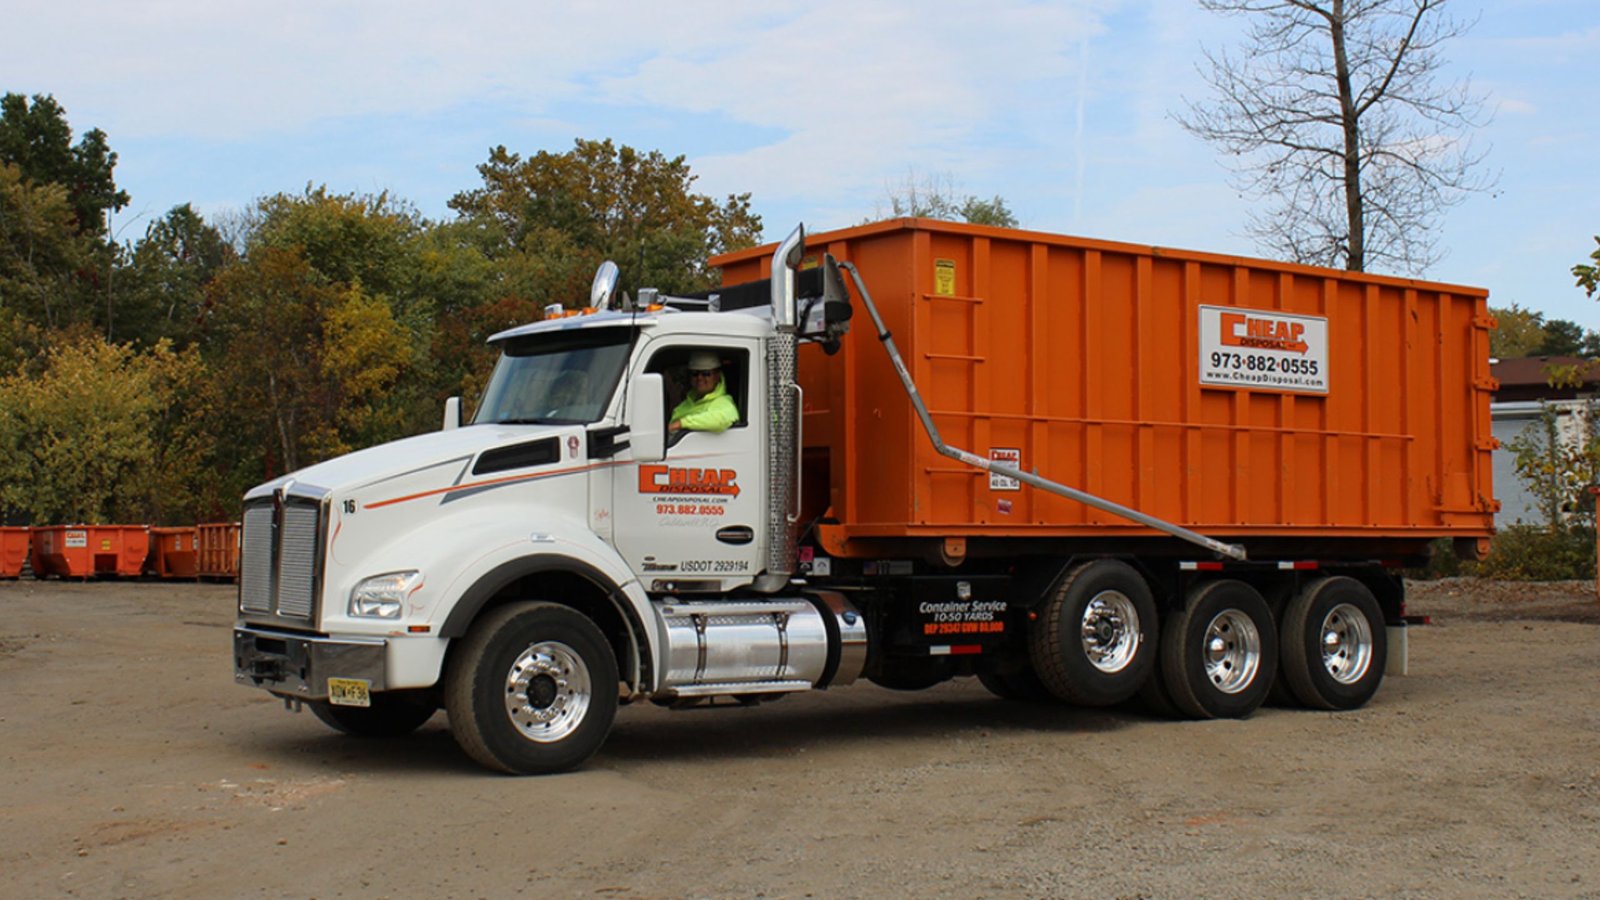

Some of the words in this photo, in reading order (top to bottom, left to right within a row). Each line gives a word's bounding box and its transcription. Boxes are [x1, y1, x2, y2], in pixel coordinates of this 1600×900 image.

[1220, 312, 1305, 346] CHEAP
[1240, 338, 1287, 349] DISPOSAL
[1206, 371, 1324, 386] www.CheapDisposal.com
[638, 464, 737, 493] CHEAP
[659, 485, 722, 494] DISPOSAL
[343, 499, 356, 514] 16
[656, 504, 725, 516] 973.882.0555
[680, 560, 713, 572] USDOT
[714, 560, 749, 572] 2929194
[919, 600, 971, 613] Container
[972, 600, 1008, 612] Service
[934, 612, 962, 622] 10-50
[964, 611, 994, 621] YARDS
